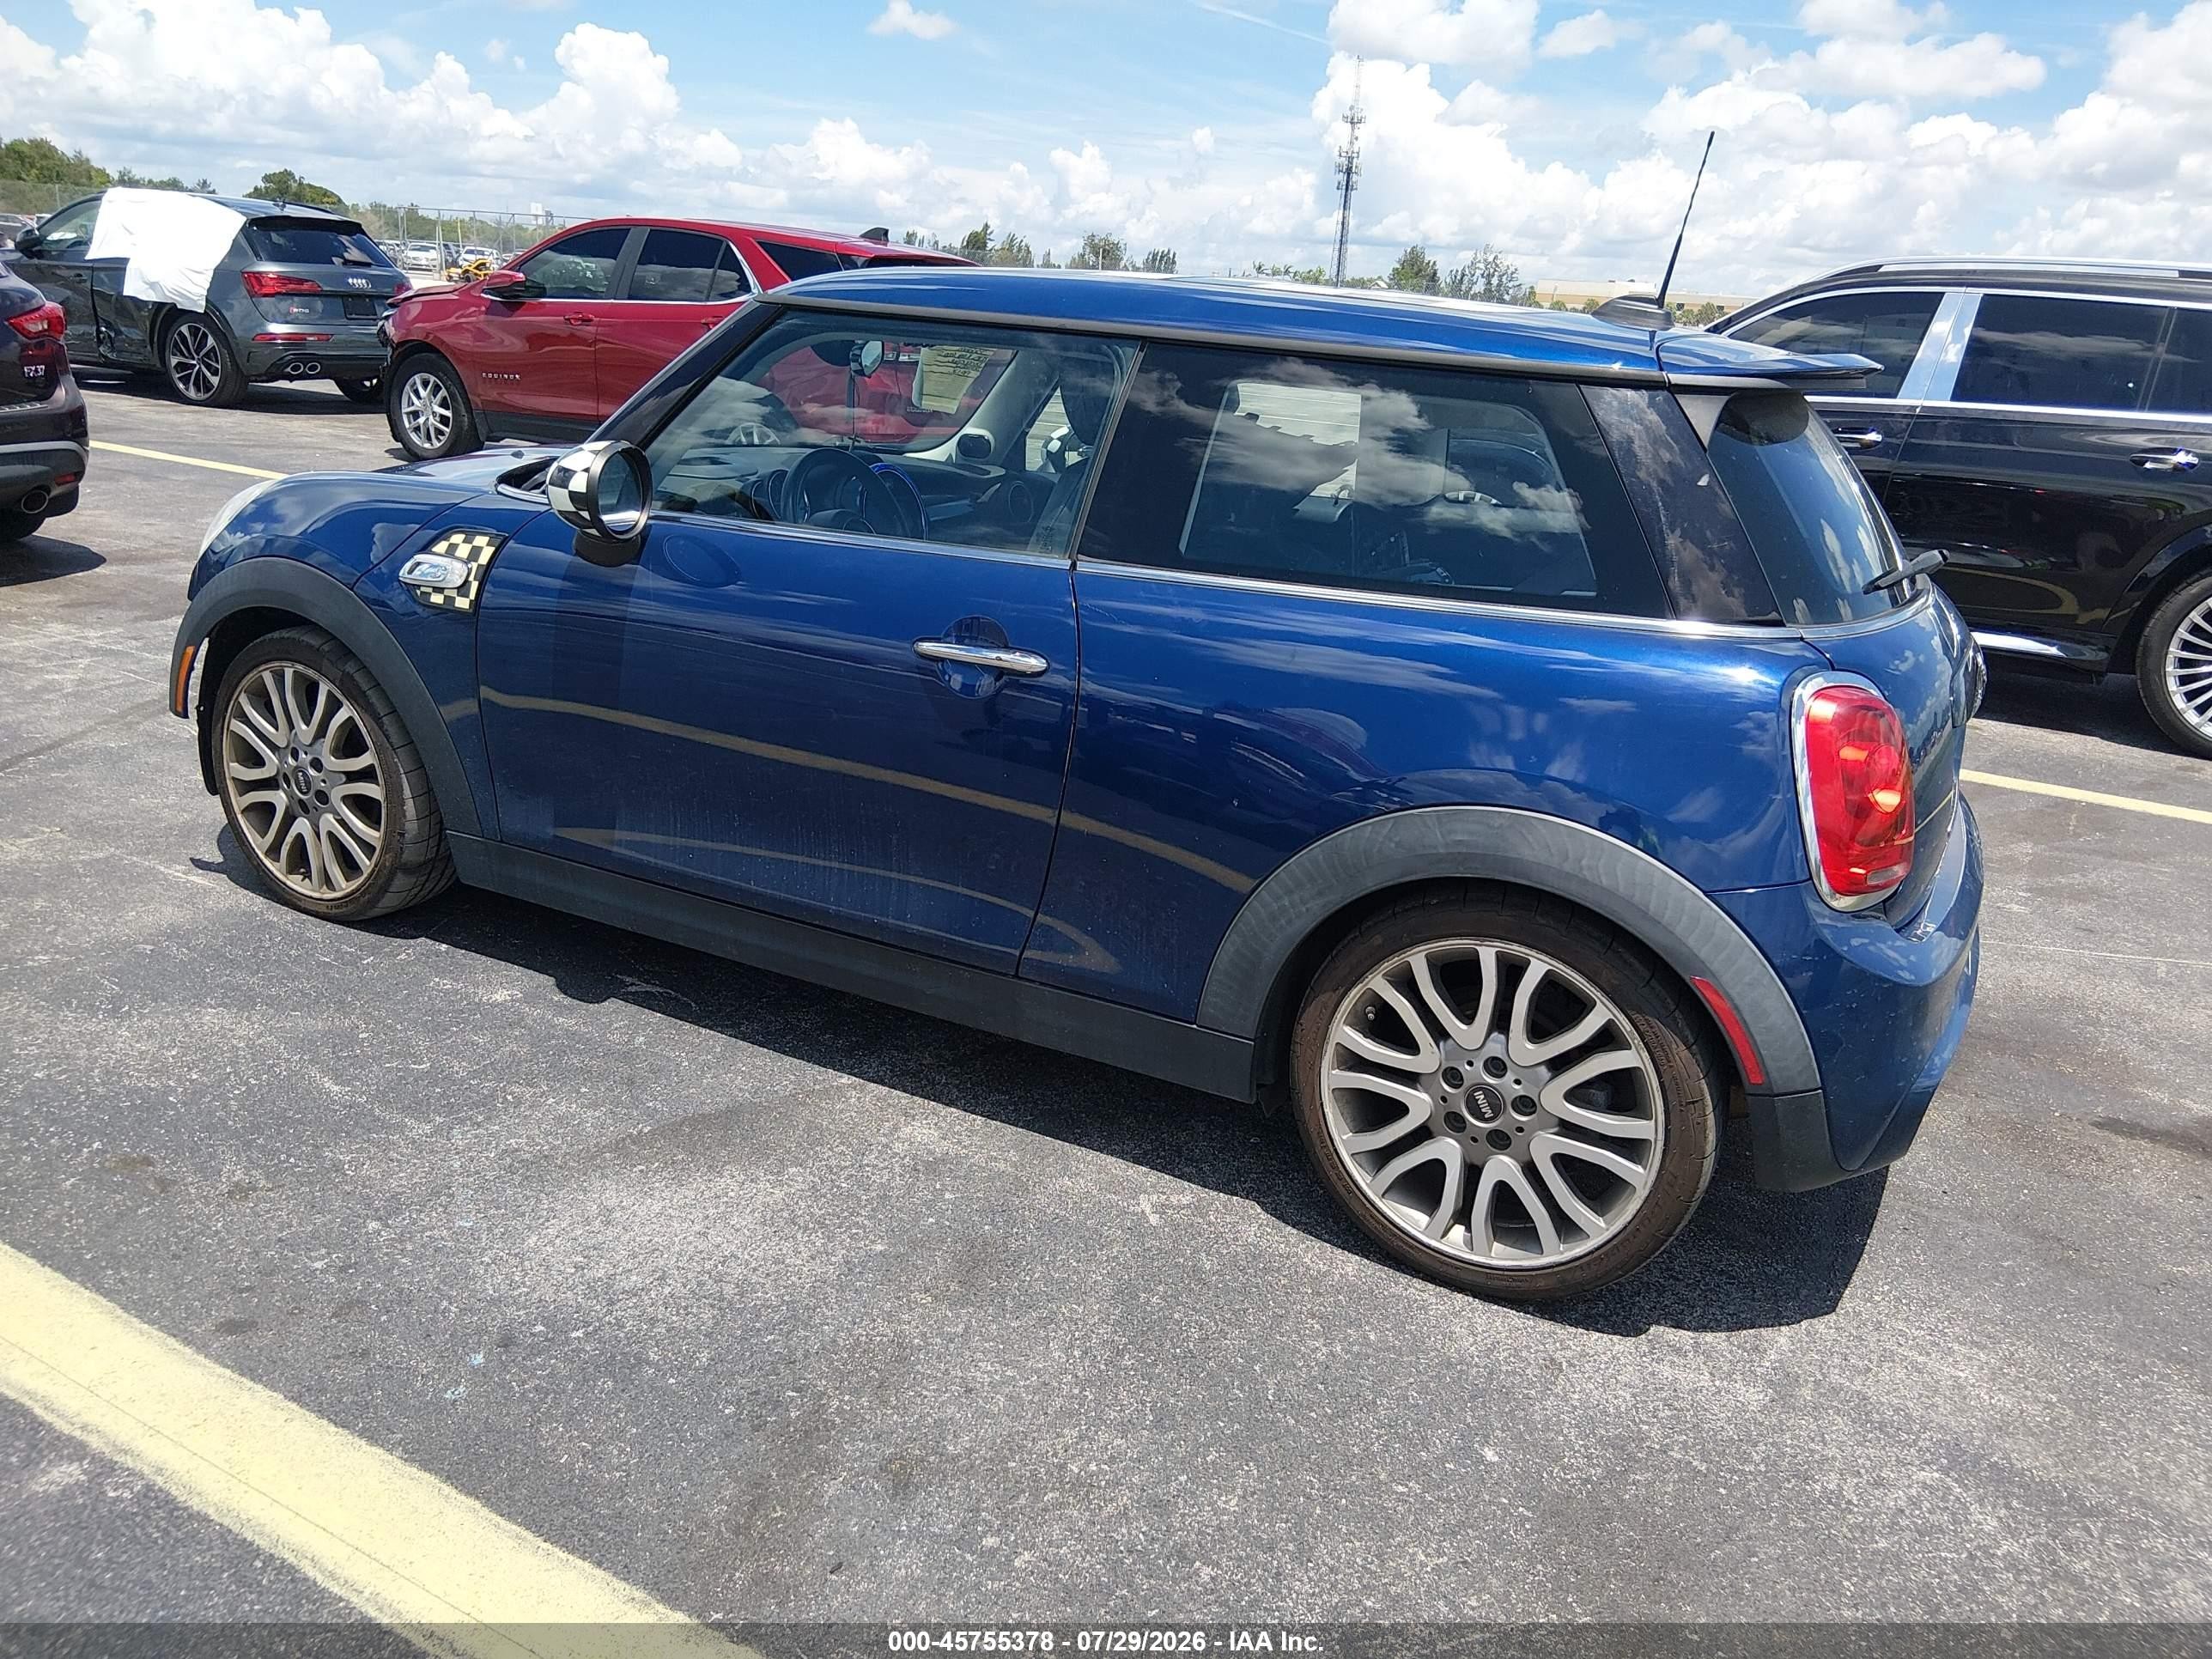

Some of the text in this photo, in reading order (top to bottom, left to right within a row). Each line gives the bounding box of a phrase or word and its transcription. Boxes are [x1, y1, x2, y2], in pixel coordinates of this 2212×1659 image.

[482, 372, 521, 380] EQUINOX
[297, 772, 307, 793] MINI
[1473, 1091, 1494, 1119] MINI
